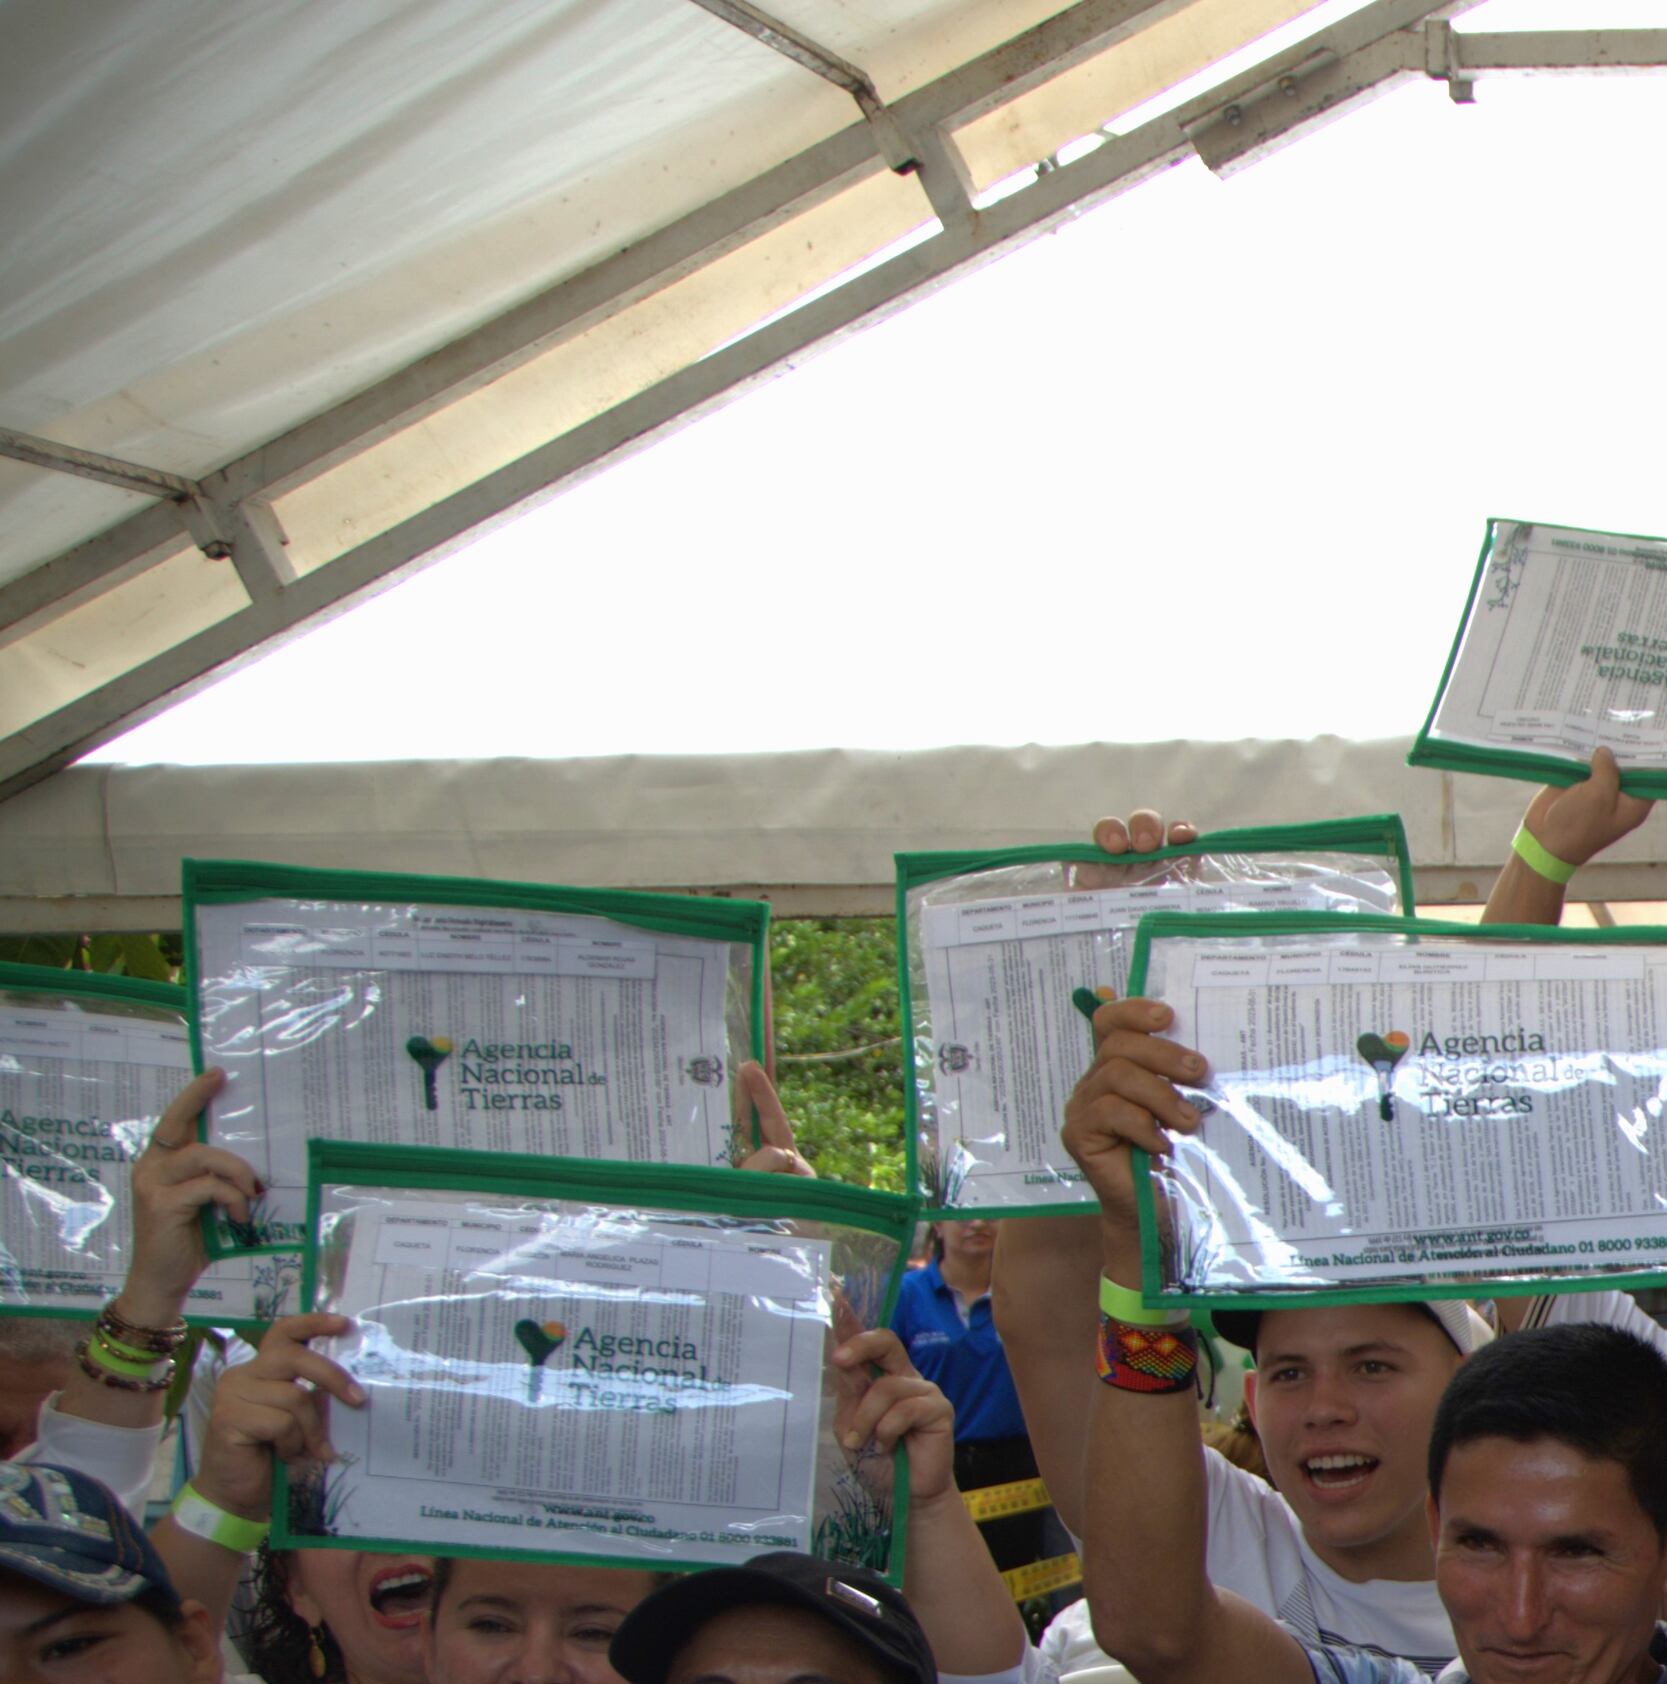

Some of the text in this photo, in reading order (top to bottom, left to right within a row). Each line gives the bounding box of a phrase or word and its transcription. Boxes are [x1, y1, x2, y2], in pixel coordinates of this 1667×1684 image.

[1200, 953, 1266, 962] DEPARTAMENTO
[461, 1038, 573, 1063] Agencia
[1418, 1027, 1546, 1059] Agencia
[461, 1064, 606, 1087] Nacional de
[1418, 1058, 1584, 1089] Nacional de
[461, 1089, 563, 1111] Tierras
[1420, 1091, 1533, 1118] Tierras
[0, 1109, 112, 1137] Agencia
[1332, 1237, 1632, 1267] Nacional de Atención Ciudadano 01 8000
[574, 1326, 698, 1361] Agencia
[572, 1354, 708, 1391] Nacional
[567, 1383, 678, 1416] Tierras
[421, 1505, 715, 1543] Línea Nacional de Atención al Ciudadano 01
